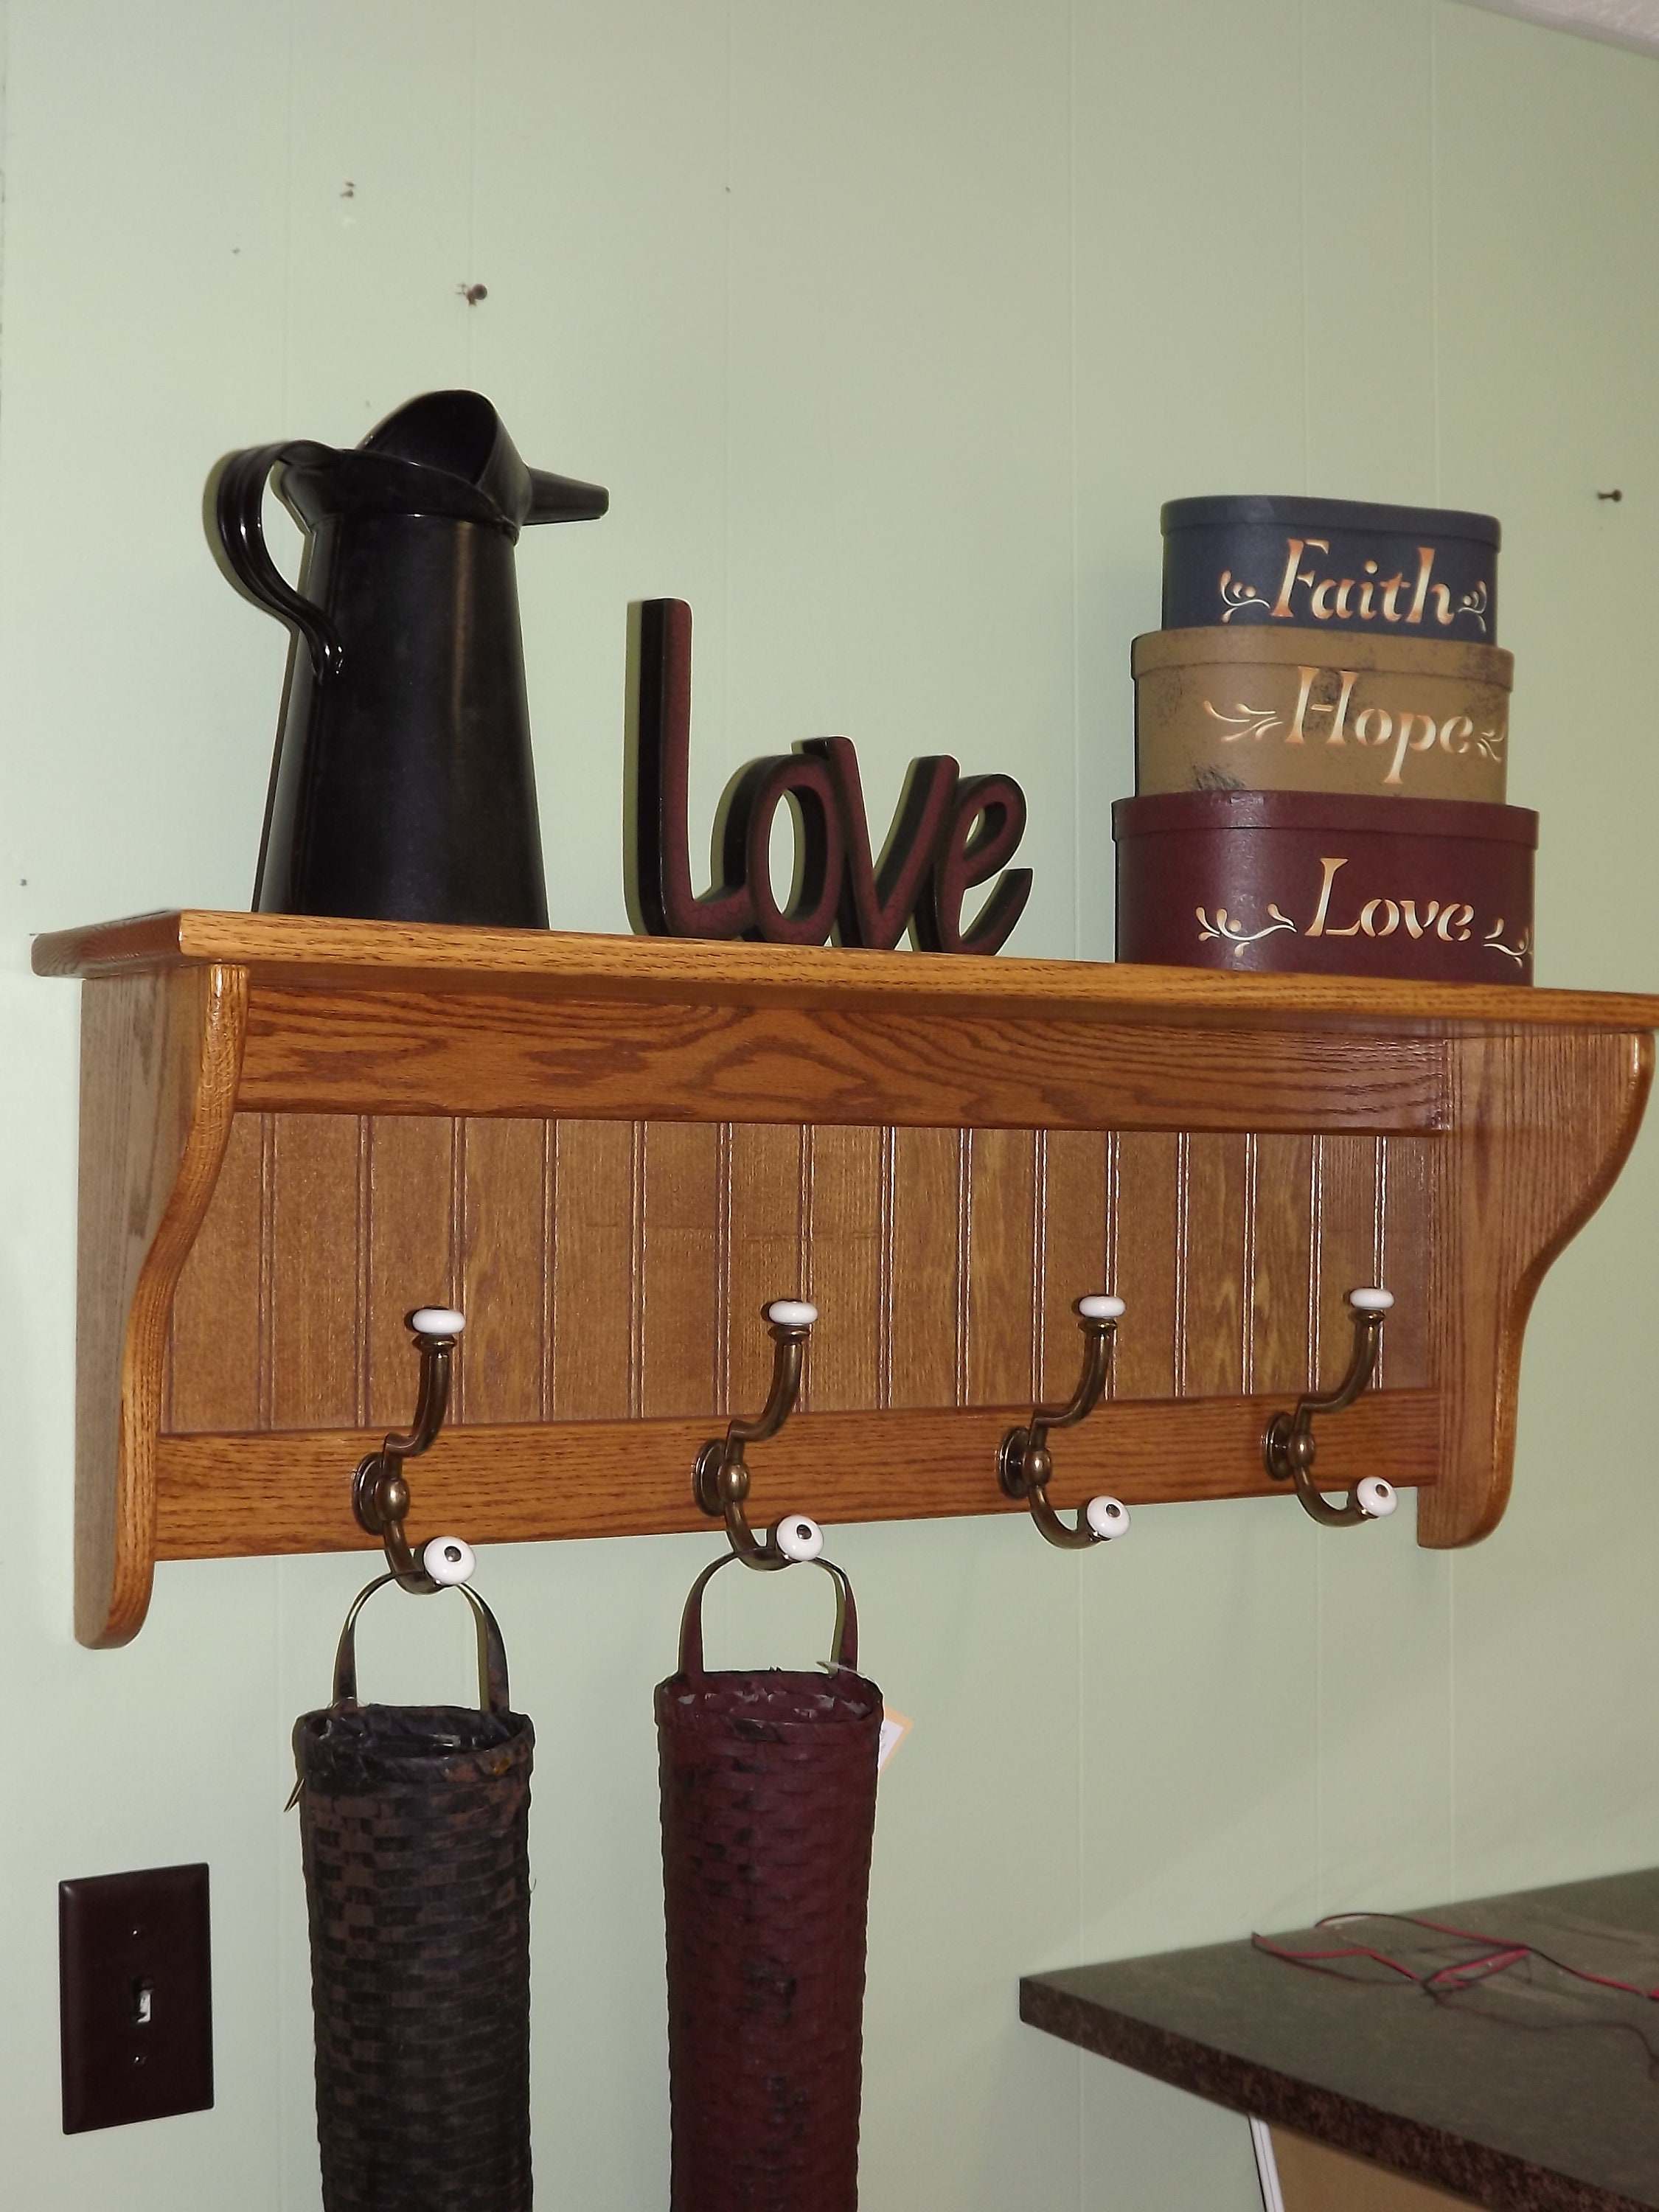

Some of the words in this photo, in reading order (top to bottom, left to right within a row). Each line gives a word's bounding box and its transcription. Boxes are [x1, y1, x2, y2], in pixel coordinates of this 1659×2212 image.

[1271, 538, 1455, 625] Faith
[1284, 666, 1474, 784] Hope
[1304, 858, 1475, 942] Love
